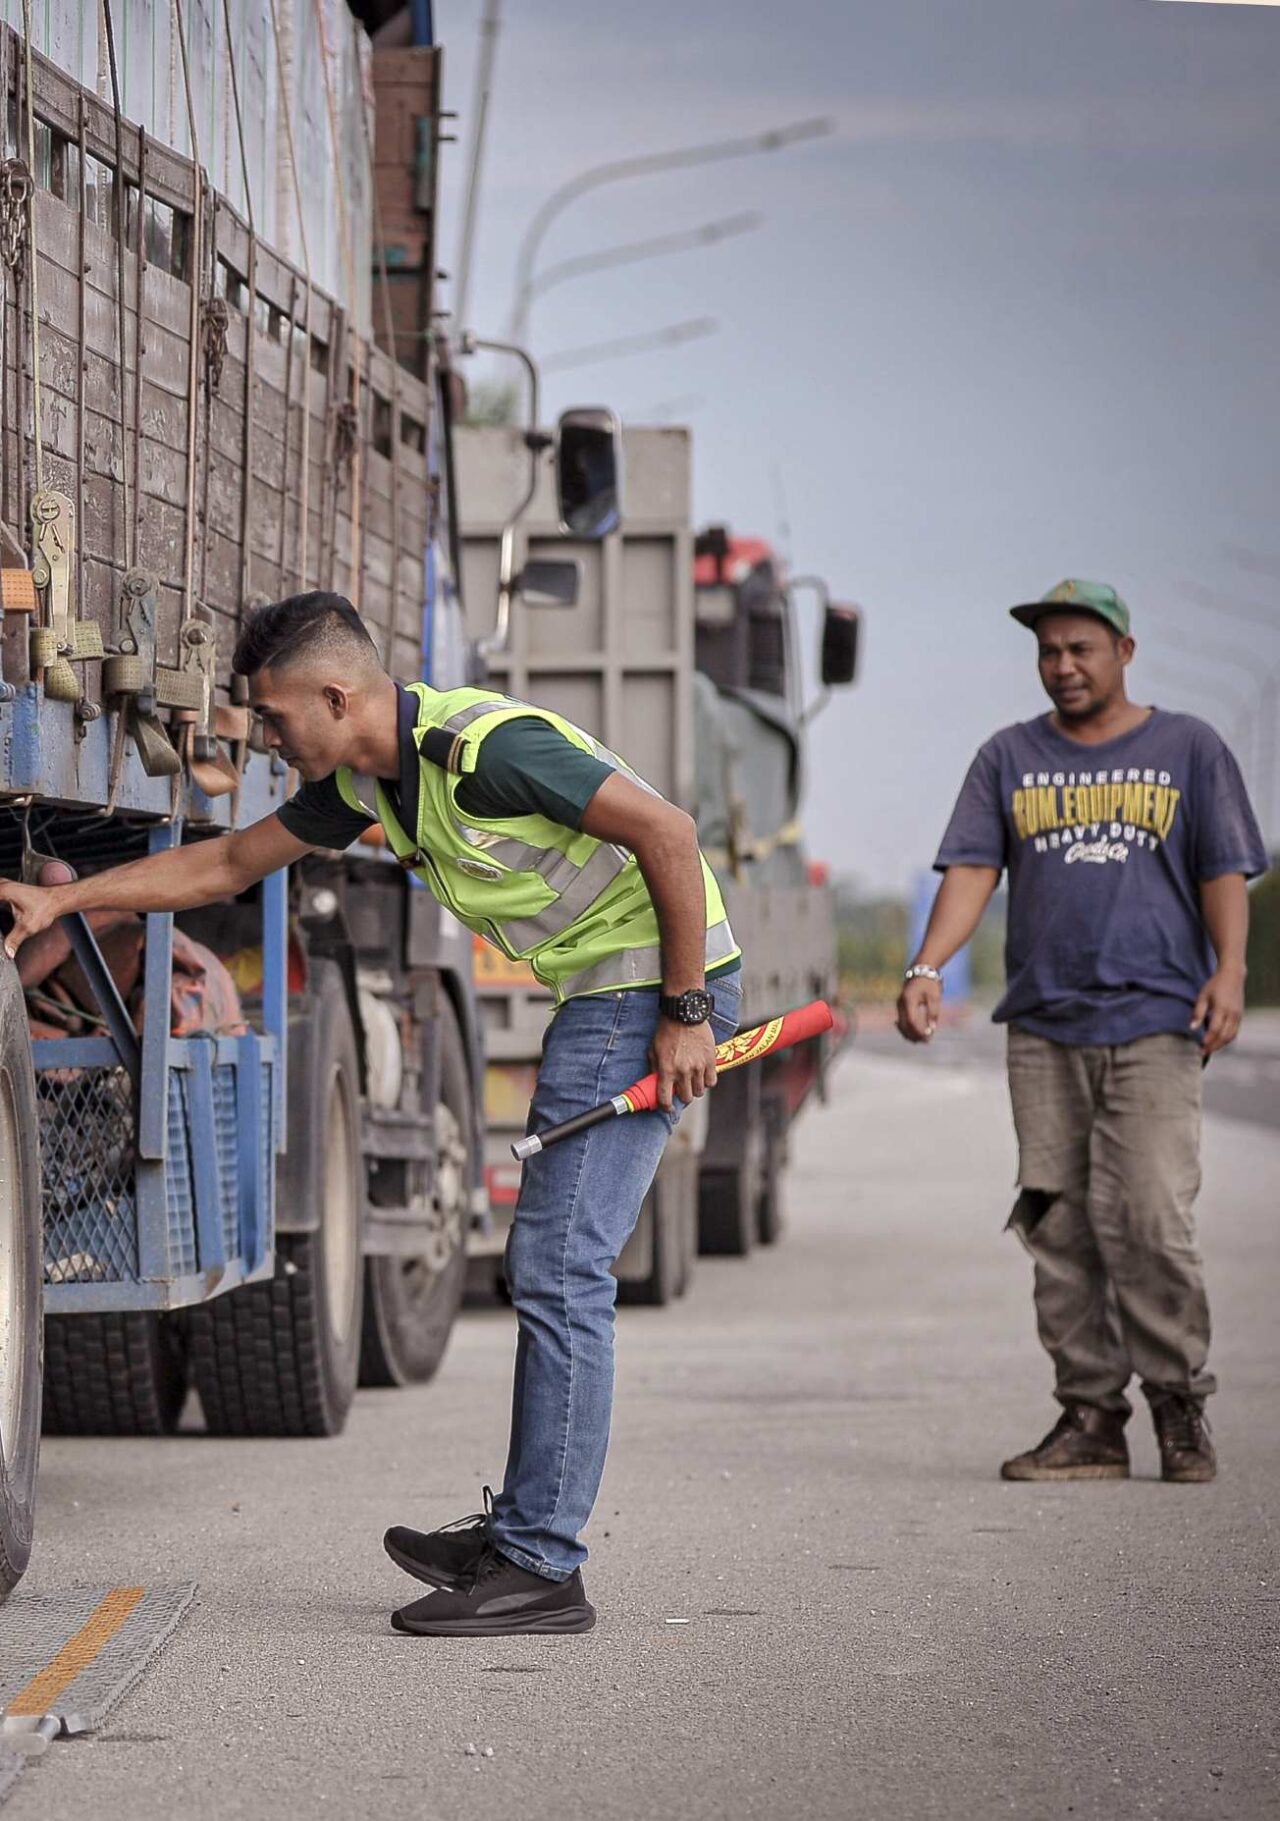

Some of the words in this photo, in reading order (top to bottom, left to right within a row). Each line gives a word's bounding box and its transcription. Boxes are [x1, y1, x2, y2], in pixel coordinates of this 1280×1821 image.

[1022, 768, 1171, 788] ENGINEERED
[1034, 822, 1100, 853] HEAVY
[1110, 821, 1158, 852] DUTY
